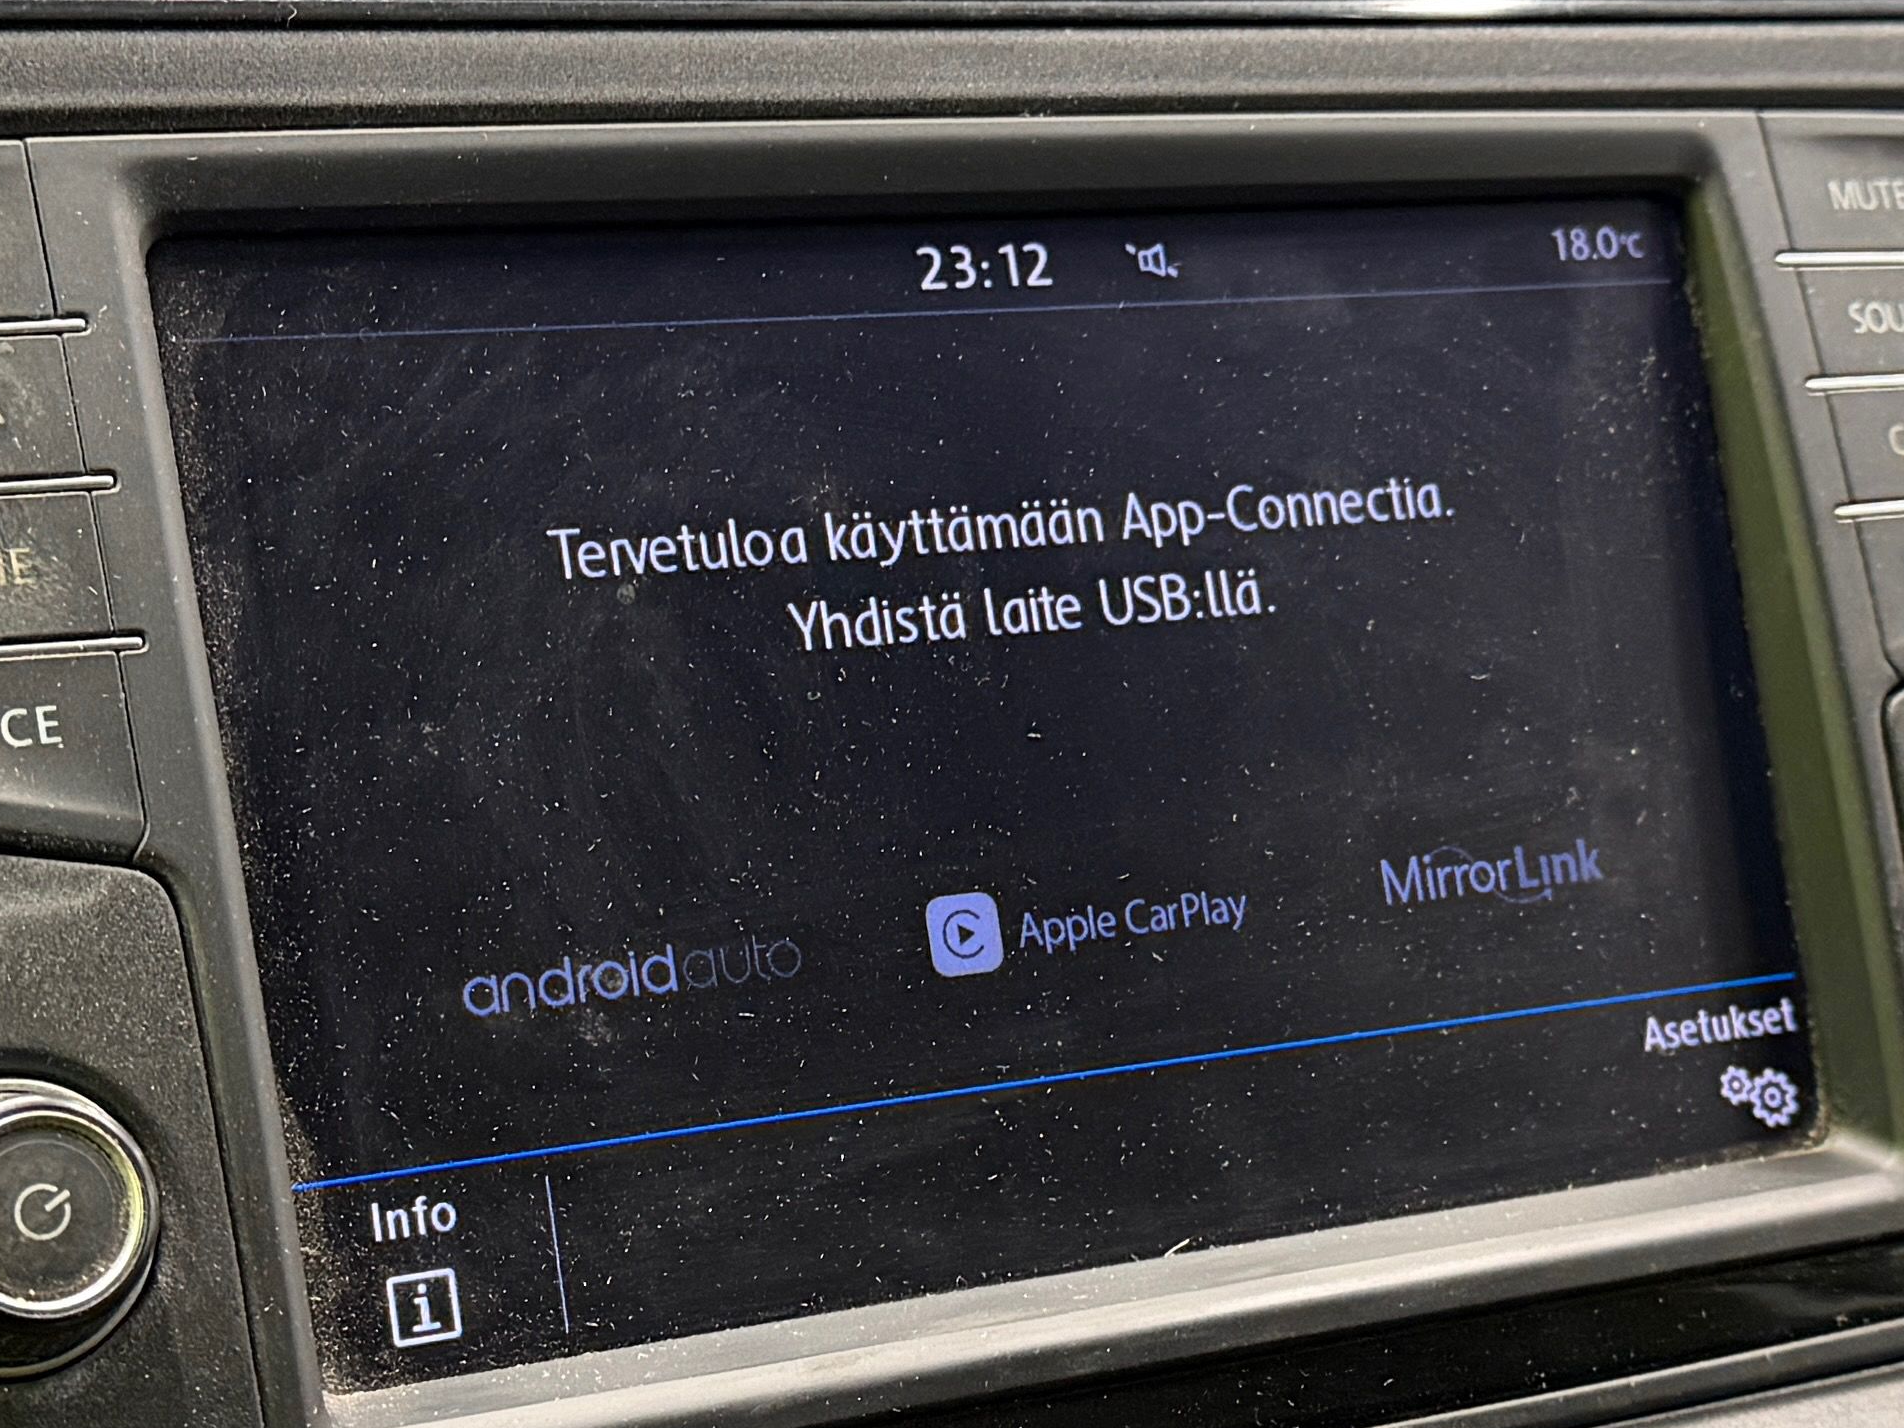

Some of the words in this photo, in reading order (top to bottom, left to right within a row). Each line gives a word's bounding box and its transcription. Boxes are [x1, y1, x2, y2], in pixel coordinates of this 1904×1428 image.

[915, 242, 1053, 291] 23:12
[546, 518, 809, 579] Tervetuloa
[824, 498, 1104, 568] käyttämään
[1122, 477, 1457, 549] App-Connectia.
[787, 590, 967, 652] Yhdistä
[984, 586, 1083, 636] laite
[1098, 568, 1277, 627] USB:llä.
[1380, 838, 1604, 906] MirrorLink
[1019, 904, 1117, 955] Apple
[1124, 890, 1247, 932] CarPlay
[1644, 996, 1798, 1053] Asetukset
[370, 1195, 457, 1243] Info
